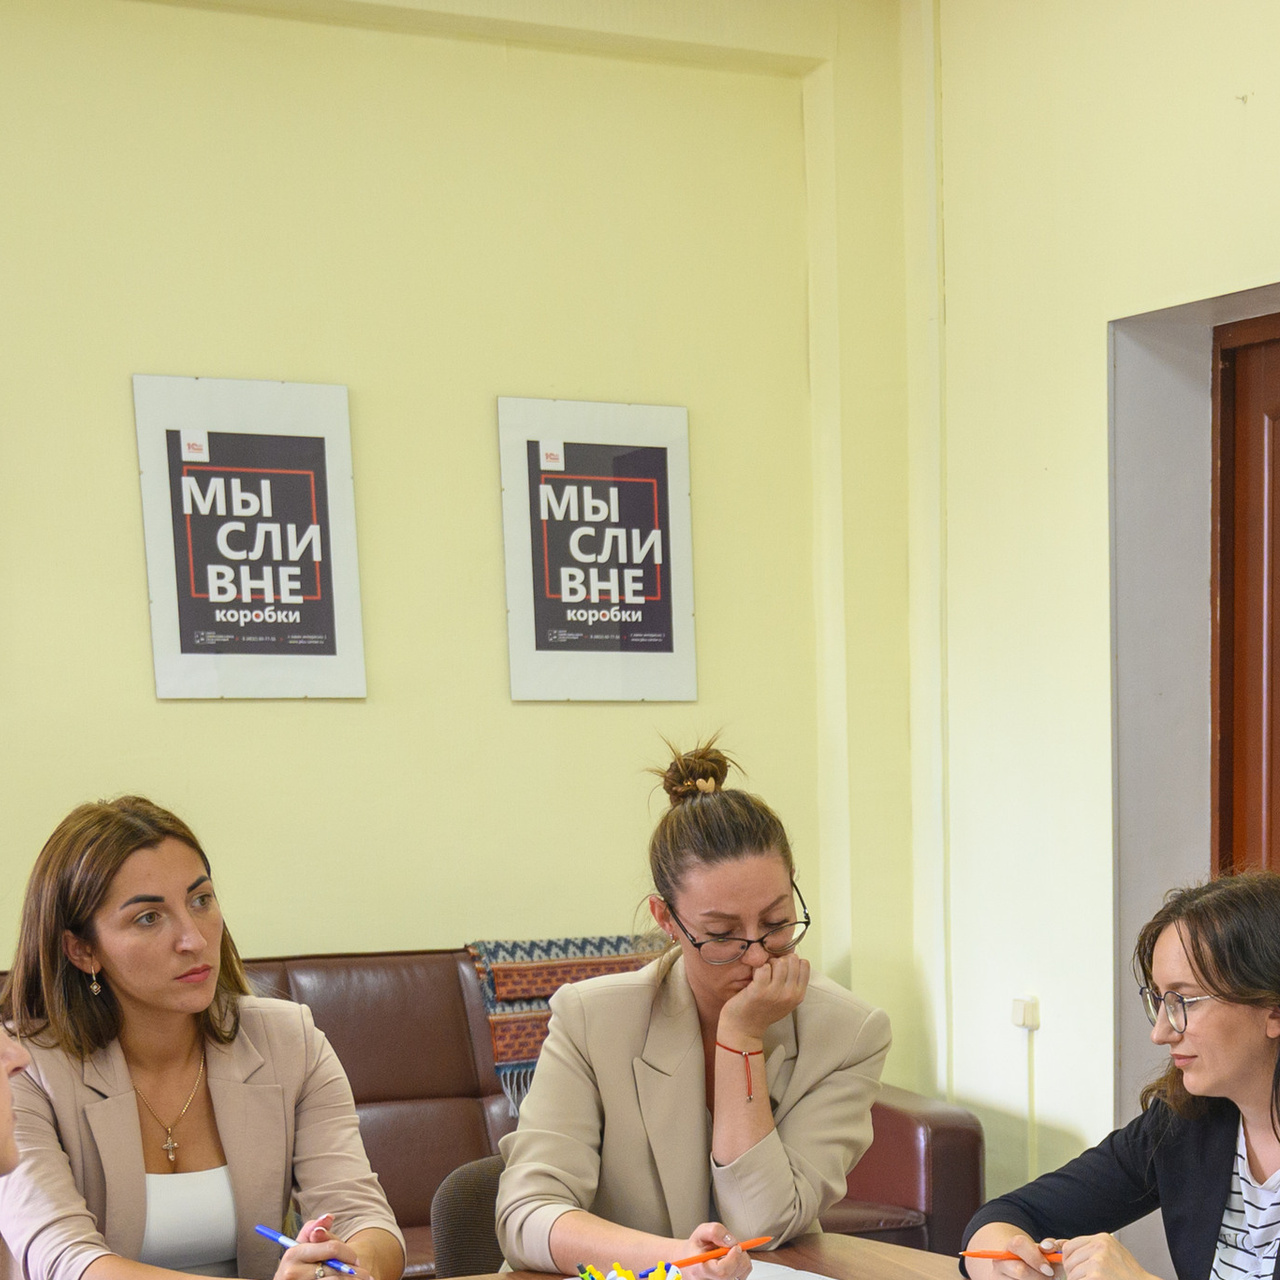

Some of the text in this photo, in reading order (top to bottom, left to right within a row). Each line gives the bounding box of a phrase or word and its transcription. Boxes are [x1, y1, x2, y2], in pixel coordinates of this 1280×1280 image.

[181, 476, 273, 518] МЫ
[539, 484, 620, 523] МЫ
[216, 521, 322, 562] СЛИ
[569, 526, 663, 564] СЛИ
[207, 564, 303, 604] ВНЕ
[560, 567, 645, 604] ВНЕ
[215, 606, 300, 627] коробки
[567, 606, 642, 625] коробки
